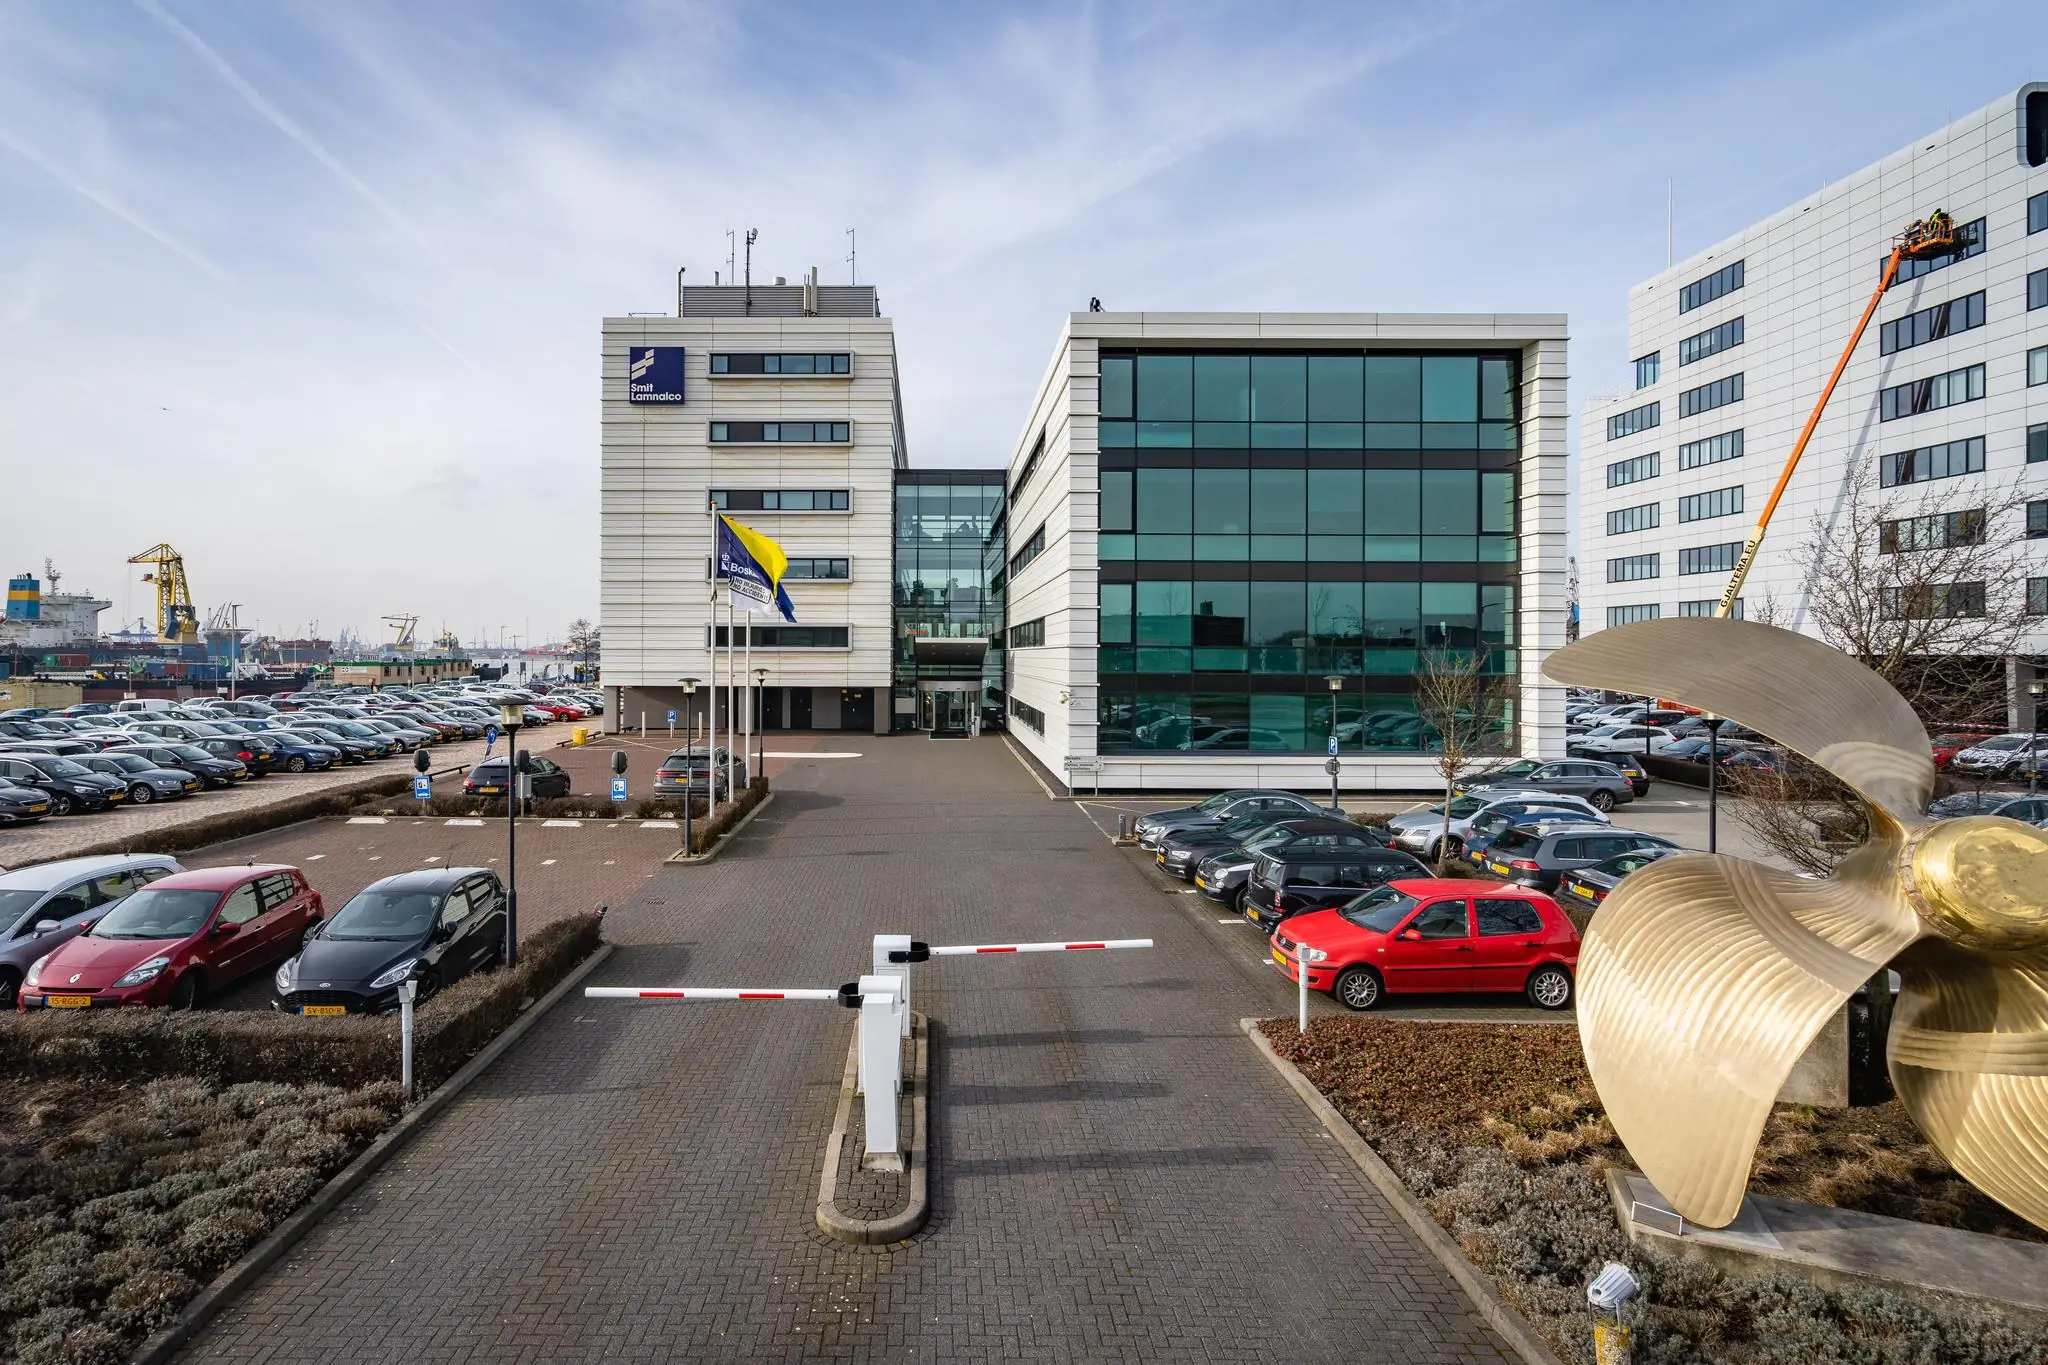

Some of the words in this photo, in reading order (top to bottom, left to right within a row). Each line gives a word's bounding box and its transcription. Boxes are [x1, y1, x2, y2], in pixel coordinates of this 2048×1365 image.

[631, 383, 653, 392] Smit
[631, 392, 682, 401] Lamnalco
[1720, 540, 1756, 608] GJALTEMA.EU
[734, 577, 742, 585] NO
[732, 582, 741, 590] NO
